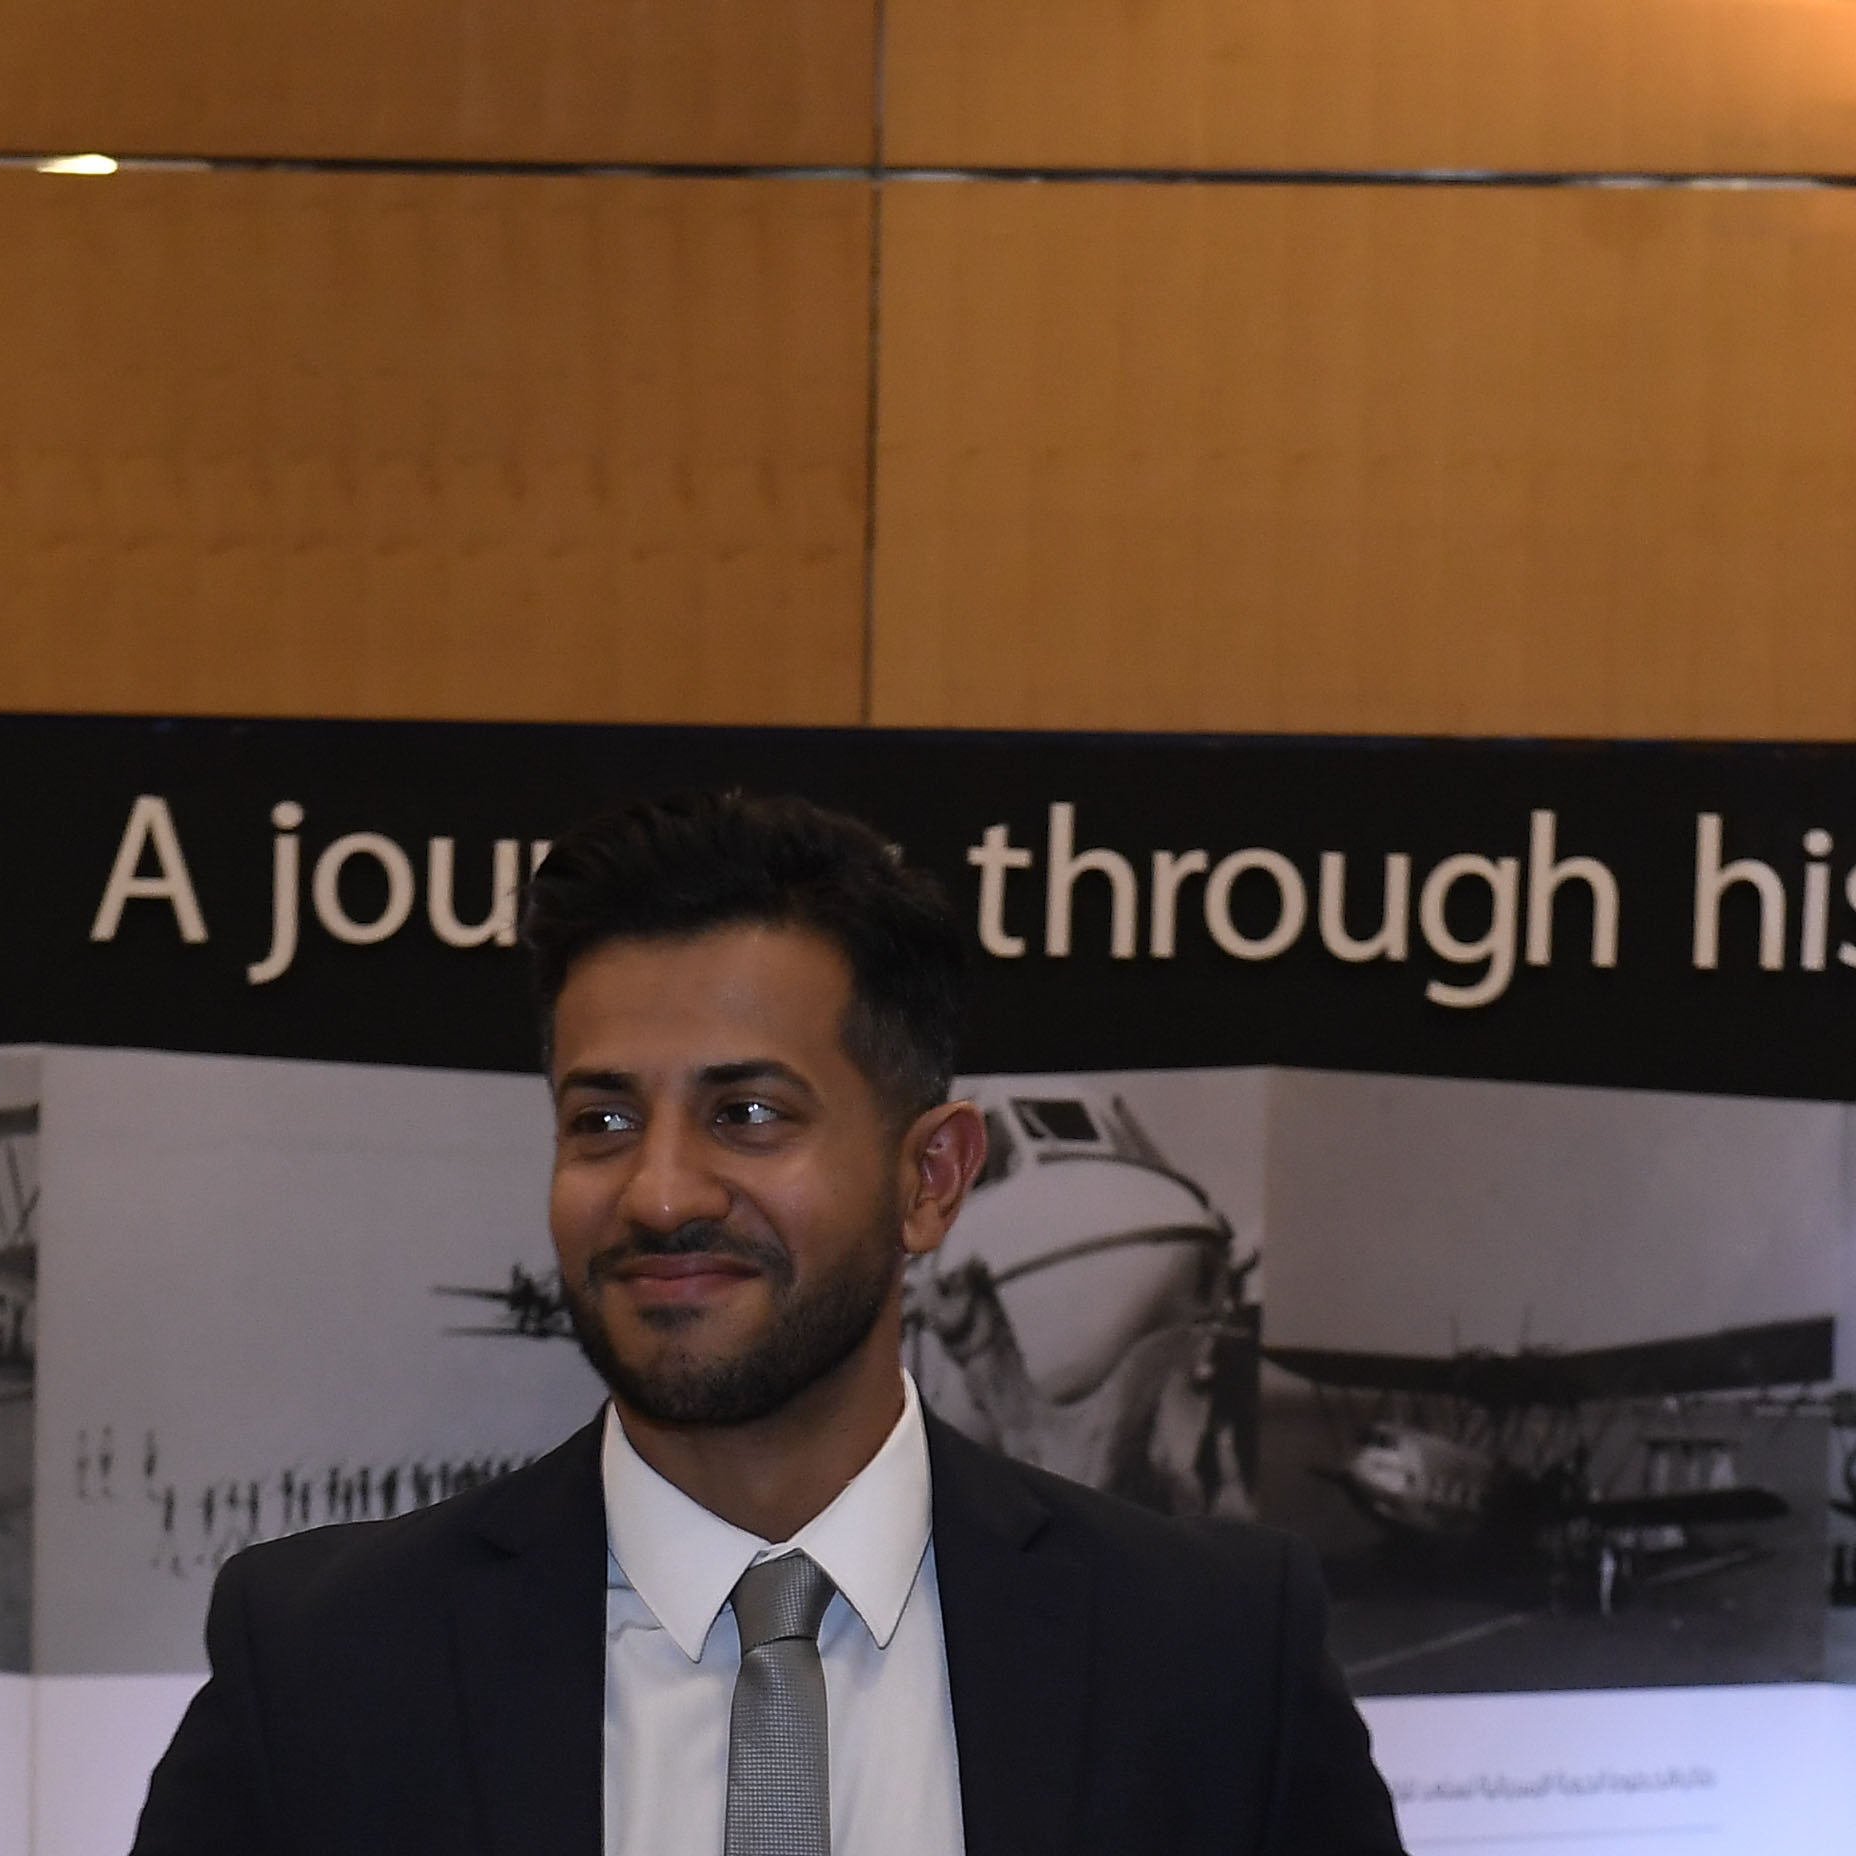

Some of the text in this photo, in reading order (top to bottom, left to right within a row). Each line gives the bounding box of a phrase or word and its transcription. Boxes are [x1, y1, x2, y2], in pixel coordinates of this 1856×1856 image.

[92, 796, 205, 941] A
[249, 802, 553, 982] jou
[969, 803, 1617, 1006] through
